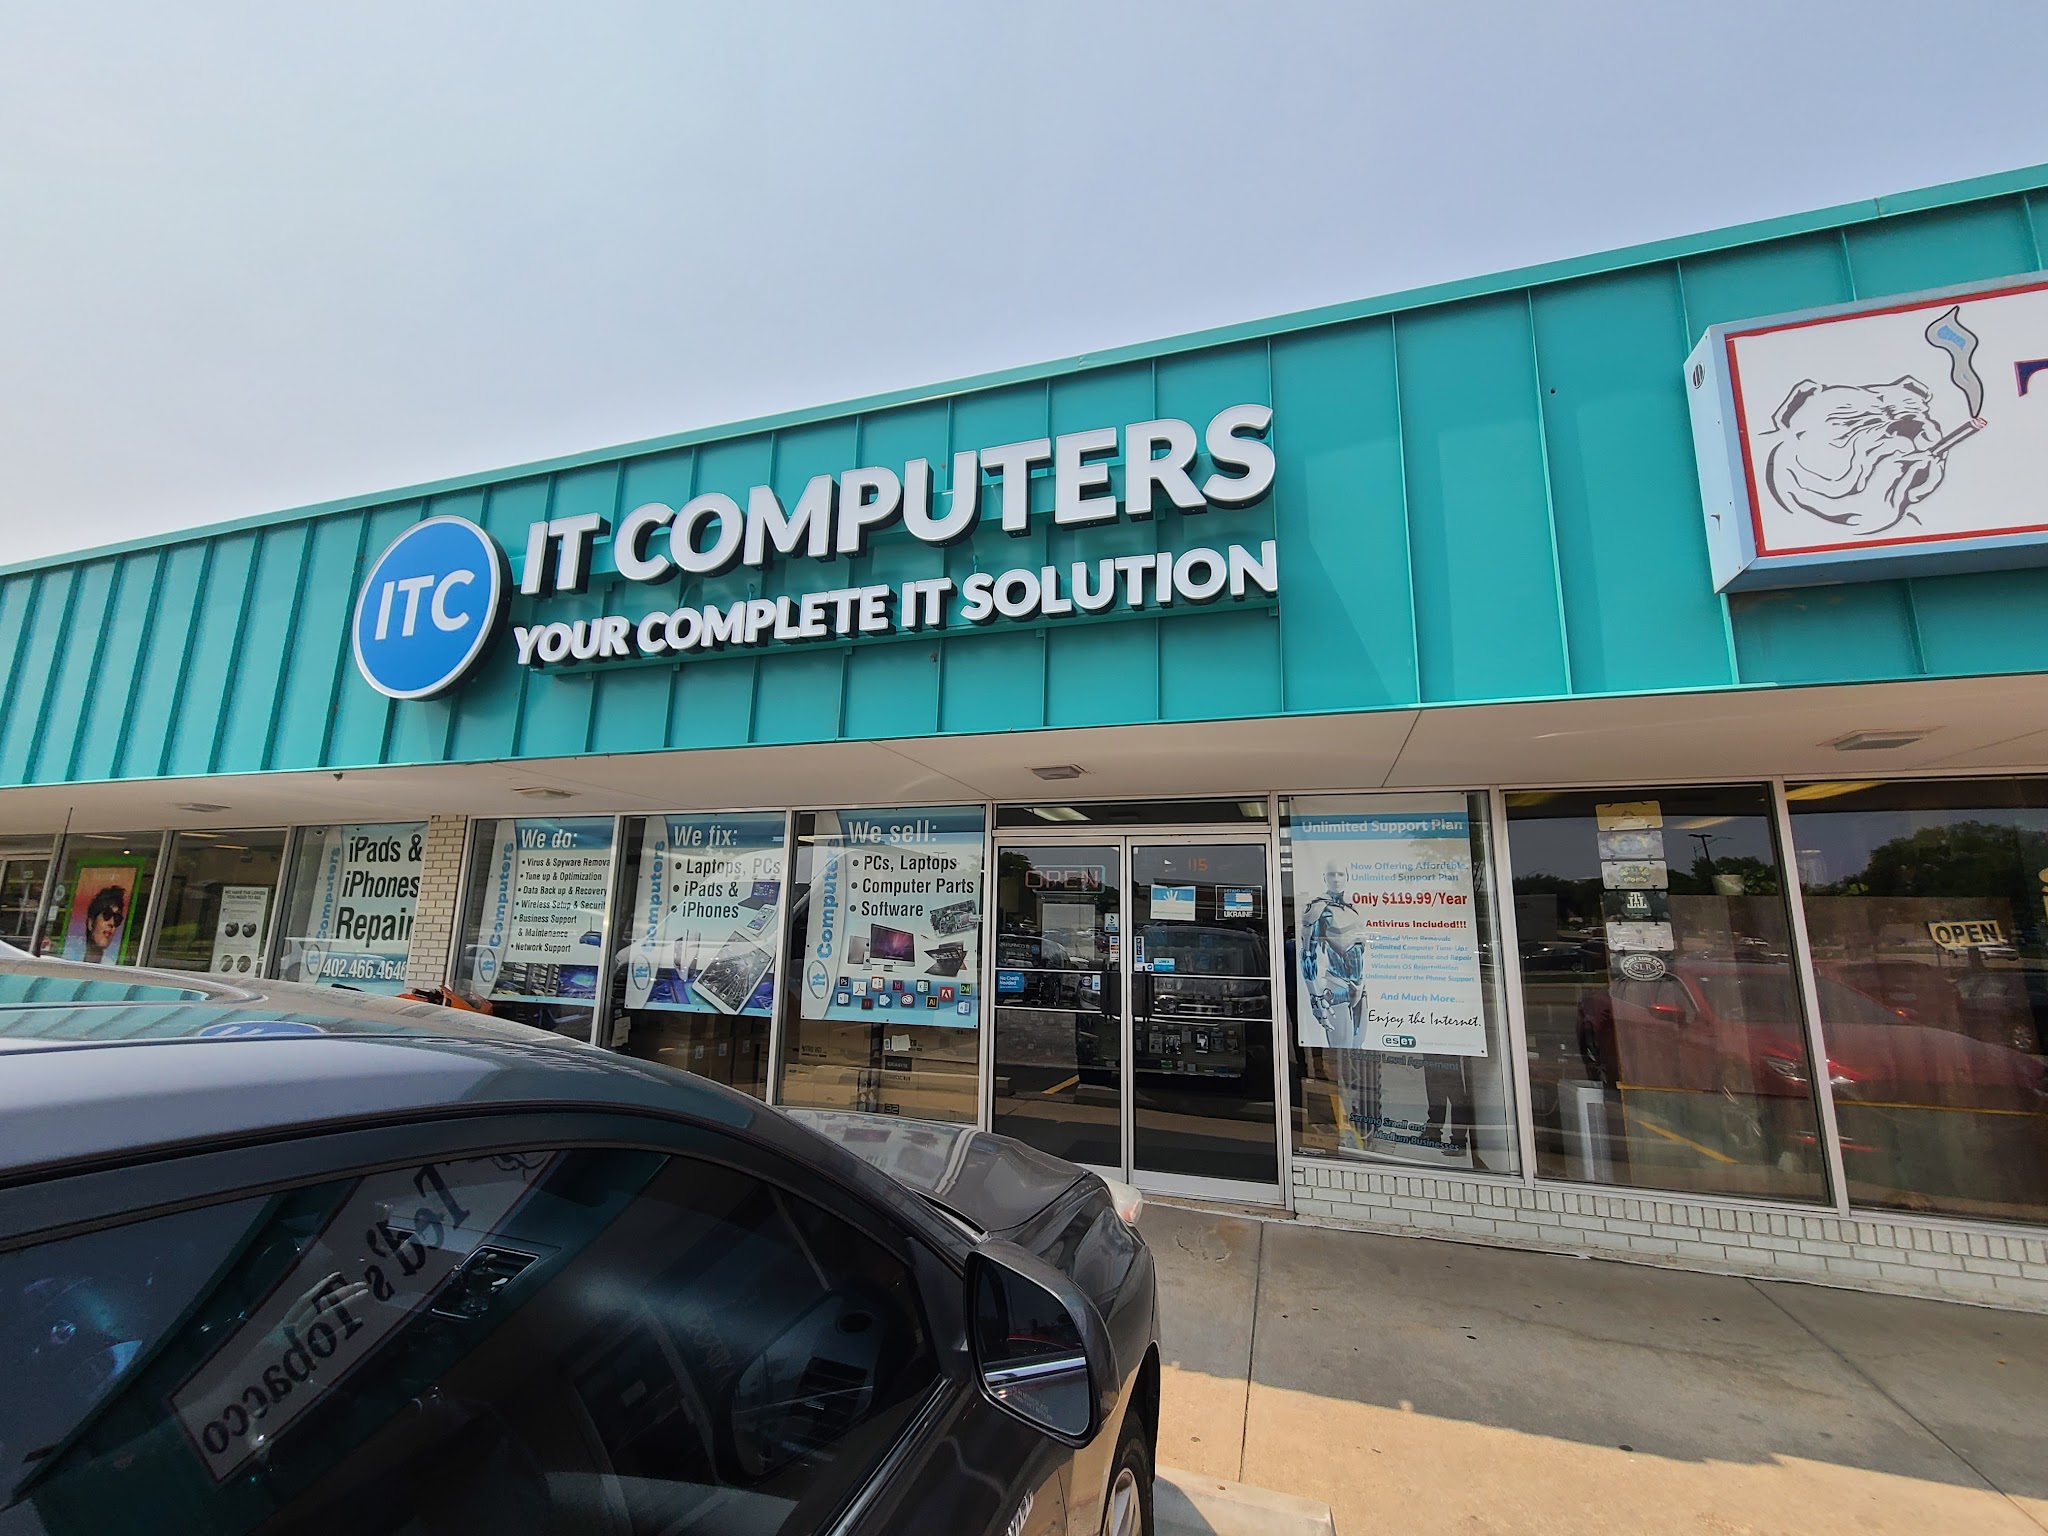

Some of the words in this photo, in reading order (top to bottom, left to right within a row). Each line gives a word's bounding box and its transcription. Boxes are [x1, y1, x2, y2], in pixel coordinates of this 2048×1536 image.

[519, 512, 601, 595] IT
[613, 404, 1276, 582] COMPUTERS
[374, 569, 476, 640] ITC
[513, 614, 631, 665] YOUR
[636, 583, 890, 653] COMPLETE
[901, 577, 953, 628] IT
[960, 540, 1278, 621] SOLUTION
[849, 820, 882, 843] We
[889, 819, 937, 843] sell:
[1301, 821, 1368, 833] Unlimited
[1371, 820, 1428, 833] Support
[1431, 818, 1463, 830] Plan
[521, 829, 546, 849] We
[552, 829, 578, 849] do:
[674, 825, 702, 846] We
[709, 825, 738, 846] fix:
[349, 836, 401, 862] iPads
[408, 833, 422, 862] &
[527, 858, 544, 867] Virus
[546, 858, 551, 867] &
[553, 858, 582, 869] Spyware
[583, 858, 610, 867] Remova
[686, 858, 746, 877] Laptops,
[753, 857, 781, 874] PCs
[864, 855, 894, 872] PCs,
[900, 855, 957, 873] Laptops
[1351, 862, 1372, 871] Now
[1375, 862, 1413, 872] Offering
[342, 870, 420, 898] iPhones
[525, 872, 541, 881] Tune
[543, 873, 550, 882] up
[553, 872, 557, 881] &
[560, 872, 602, 881] Optimization
[1025, 870, 1099, 889] OPEN
[1351, 873, 1396, 882] Unlimited
[1398, 874, 1436, 883] Support
[1439, 873, 1459, 881] Plan
[489, 842, 514, 947] Computers
[523, 886, 538, 895] Data
[540, 886, 556, 895] Back
[558, 887, 566, 896] up
[568, 886, 573, 895] &
[575, 886, 607, 897] Recovery
[684, 881, 723, 897] iPads
[728, 881, 738, 897] &
[862, 878, 931, 896] Computer
[936, 878, 974, 894] Parts
[521, 900, 551, 909] Wireless
[581, 900, 606, 910] Securit
[642, 840, 665, 953] Computers
[1352, 892, 1378, 907] Only
[1382, 892, 1468, 907] $119.99/Year
[682, 901, 739, 918] iPhones
[861, 901, 924, 917] Software
[336, 907, 414, 948] Repair
[519, 914, 549, 923] Business
[551, 915, 577, 925] Support
[1365, 919, 1410, 928] Antivirus
[1412, 920, 1467, 929] Included!!!
[518, 928, 523, 937] &
[525, 928, 568, 938] Maintenance
[1935, 923, 1998, 944] OPEN
[516, 942, 543, 952] Network
[544, 943, 571, 954] Support
[1402, 944, 1434, 952] Computer
[1633, 963, 1652, 971] SLR
[1380, 992, 1398, 1001] And
[1401, 992, 1427, 1002] Much
[1369, 1010, 1404, 1028] Enjoy
[1409, 1011, 1425, 1025] the
[1430, 1010, 1481, 1027] Internet.
[1407, 1056, 1459, 1071] Agreement
[1349, 1113, 1382, 1127] Serving
[1383, 1118, 1407, 1130] Small
[1409, 1121, 1427, 1132] and
[1374, 1130, 1410, 1143] Medium
[1410, 1136, 1459, 1151] Businesses
